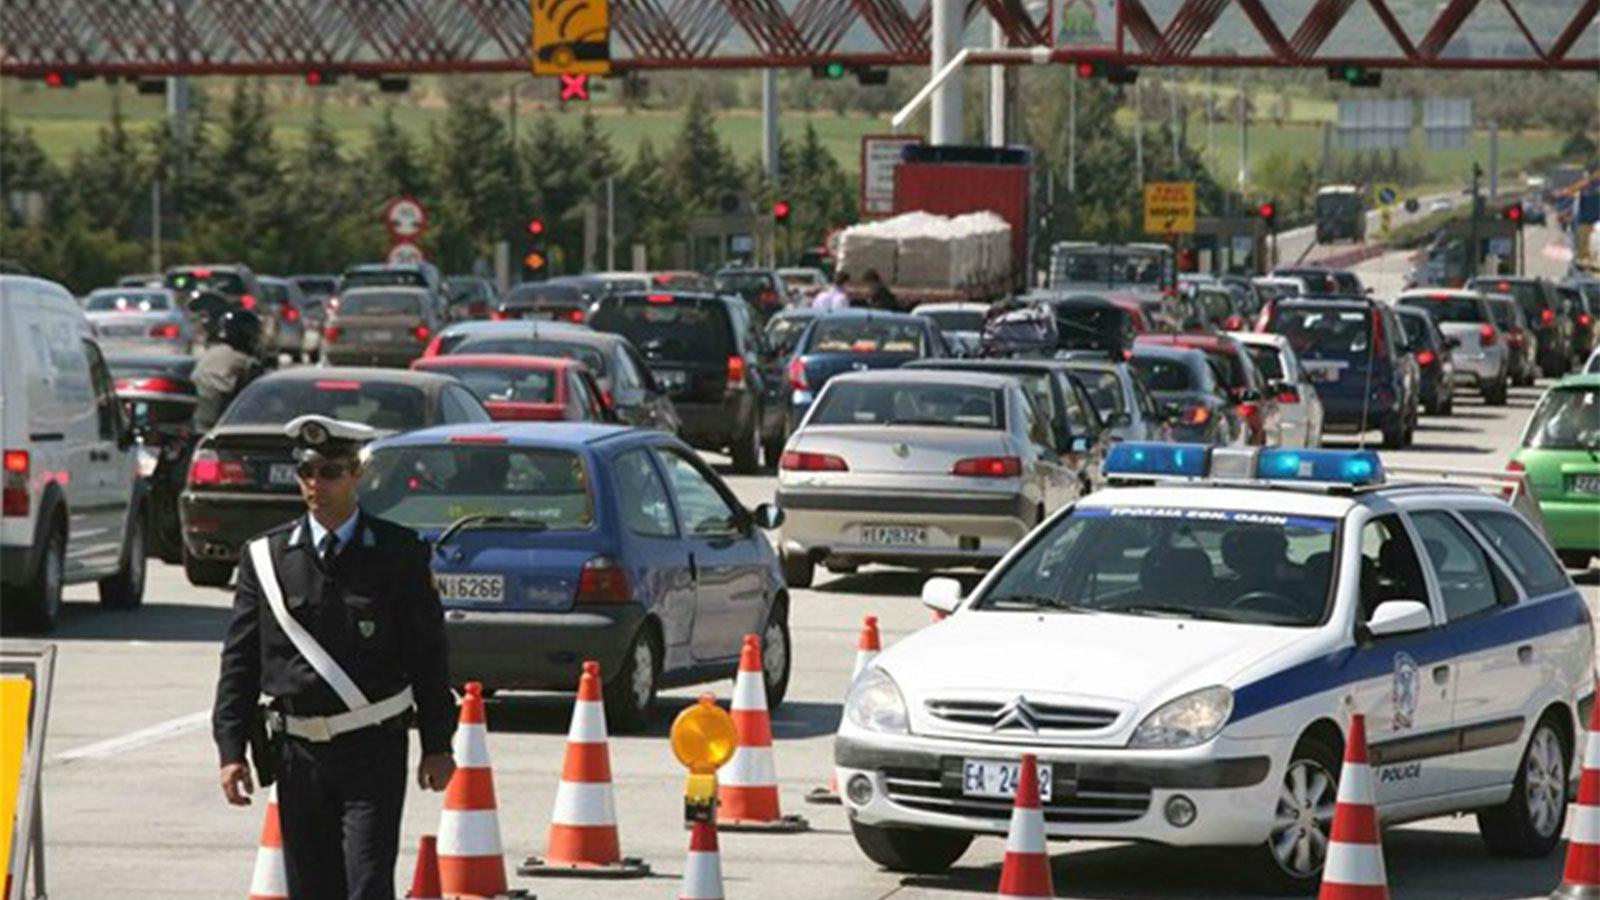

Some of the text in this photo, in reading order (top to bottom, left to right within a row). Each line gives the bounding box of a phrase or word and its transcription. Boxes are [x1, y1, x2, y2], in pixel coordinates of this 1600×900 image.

[457, 578, 501, 598] 6266
[965, 763, 986, 792] EA
[1380, 762, 1422, 784] POLICE
